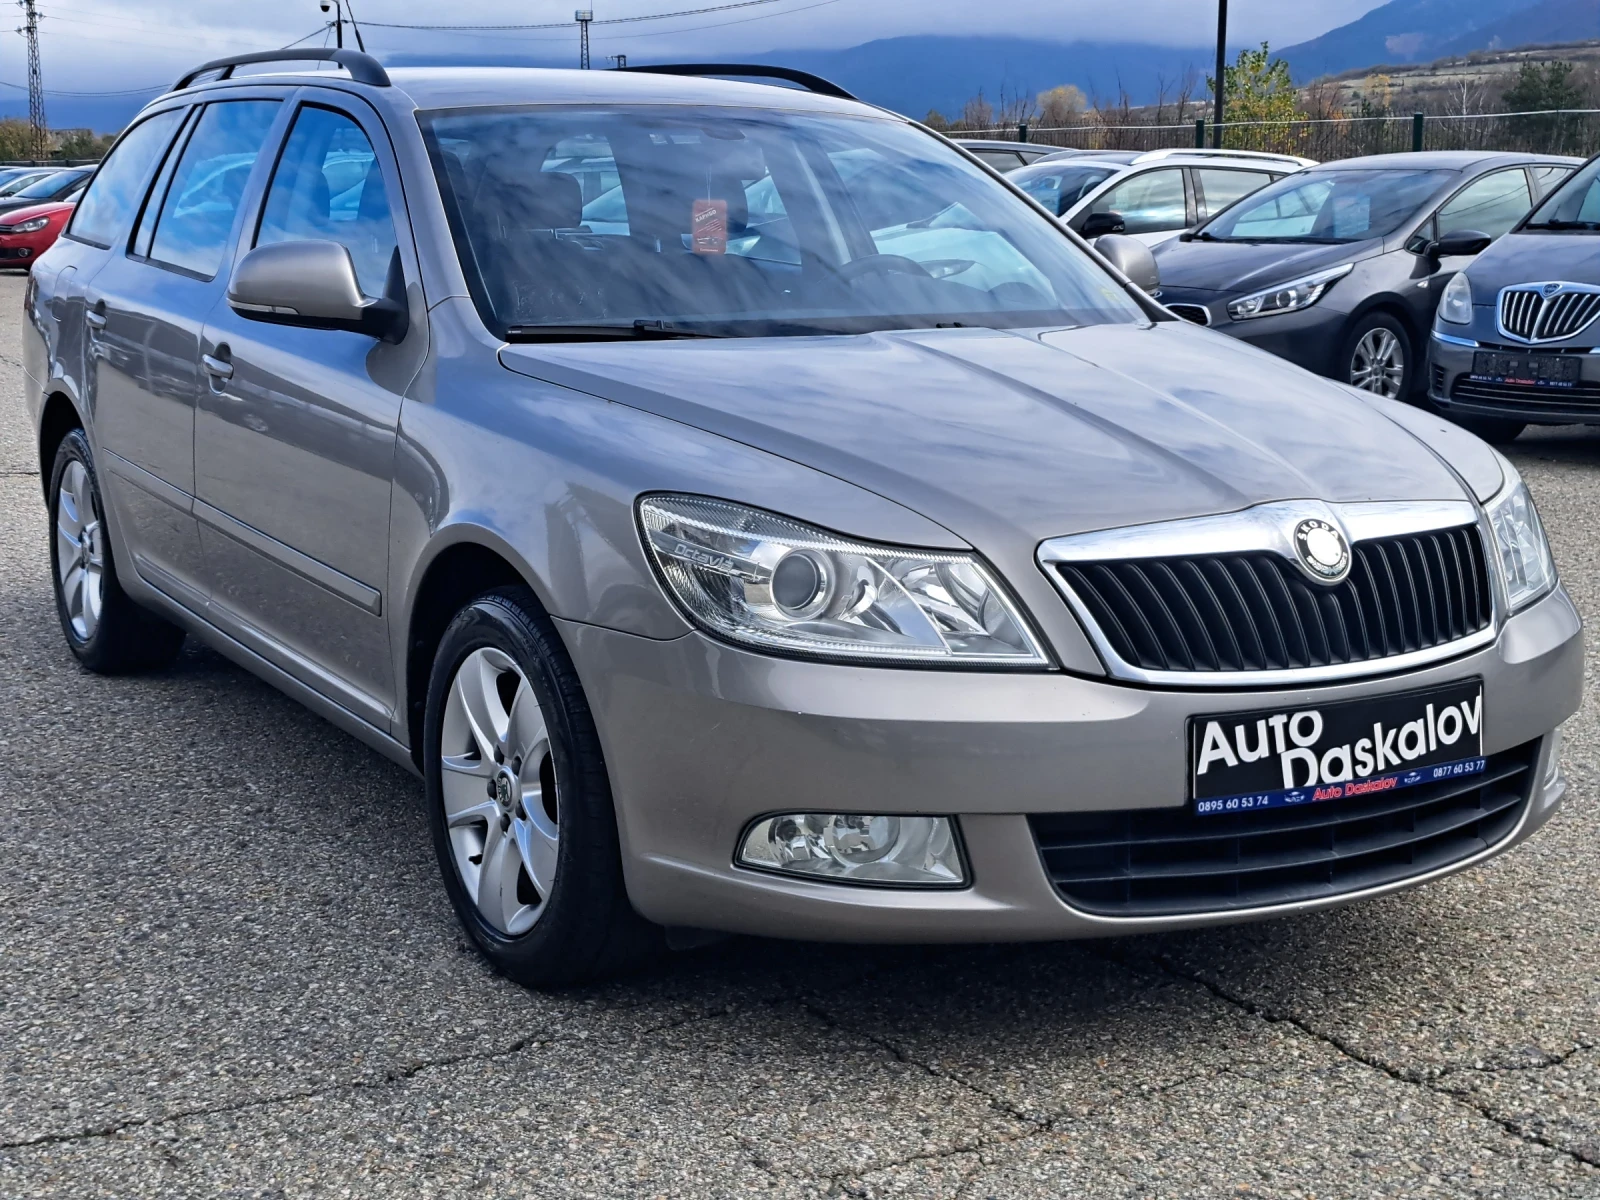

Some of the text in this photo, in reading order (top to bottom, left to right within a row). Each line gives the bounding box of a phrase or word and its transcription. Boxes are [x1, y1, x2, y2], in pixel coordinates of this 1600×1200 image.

[674, 543, 734, 571] Octavia
[1281, 695, 1482, 789] Daskalov
[1198, 759, 1486, 812] 0895 60 53 74 Auto Daskalov 0877 60 53 77
